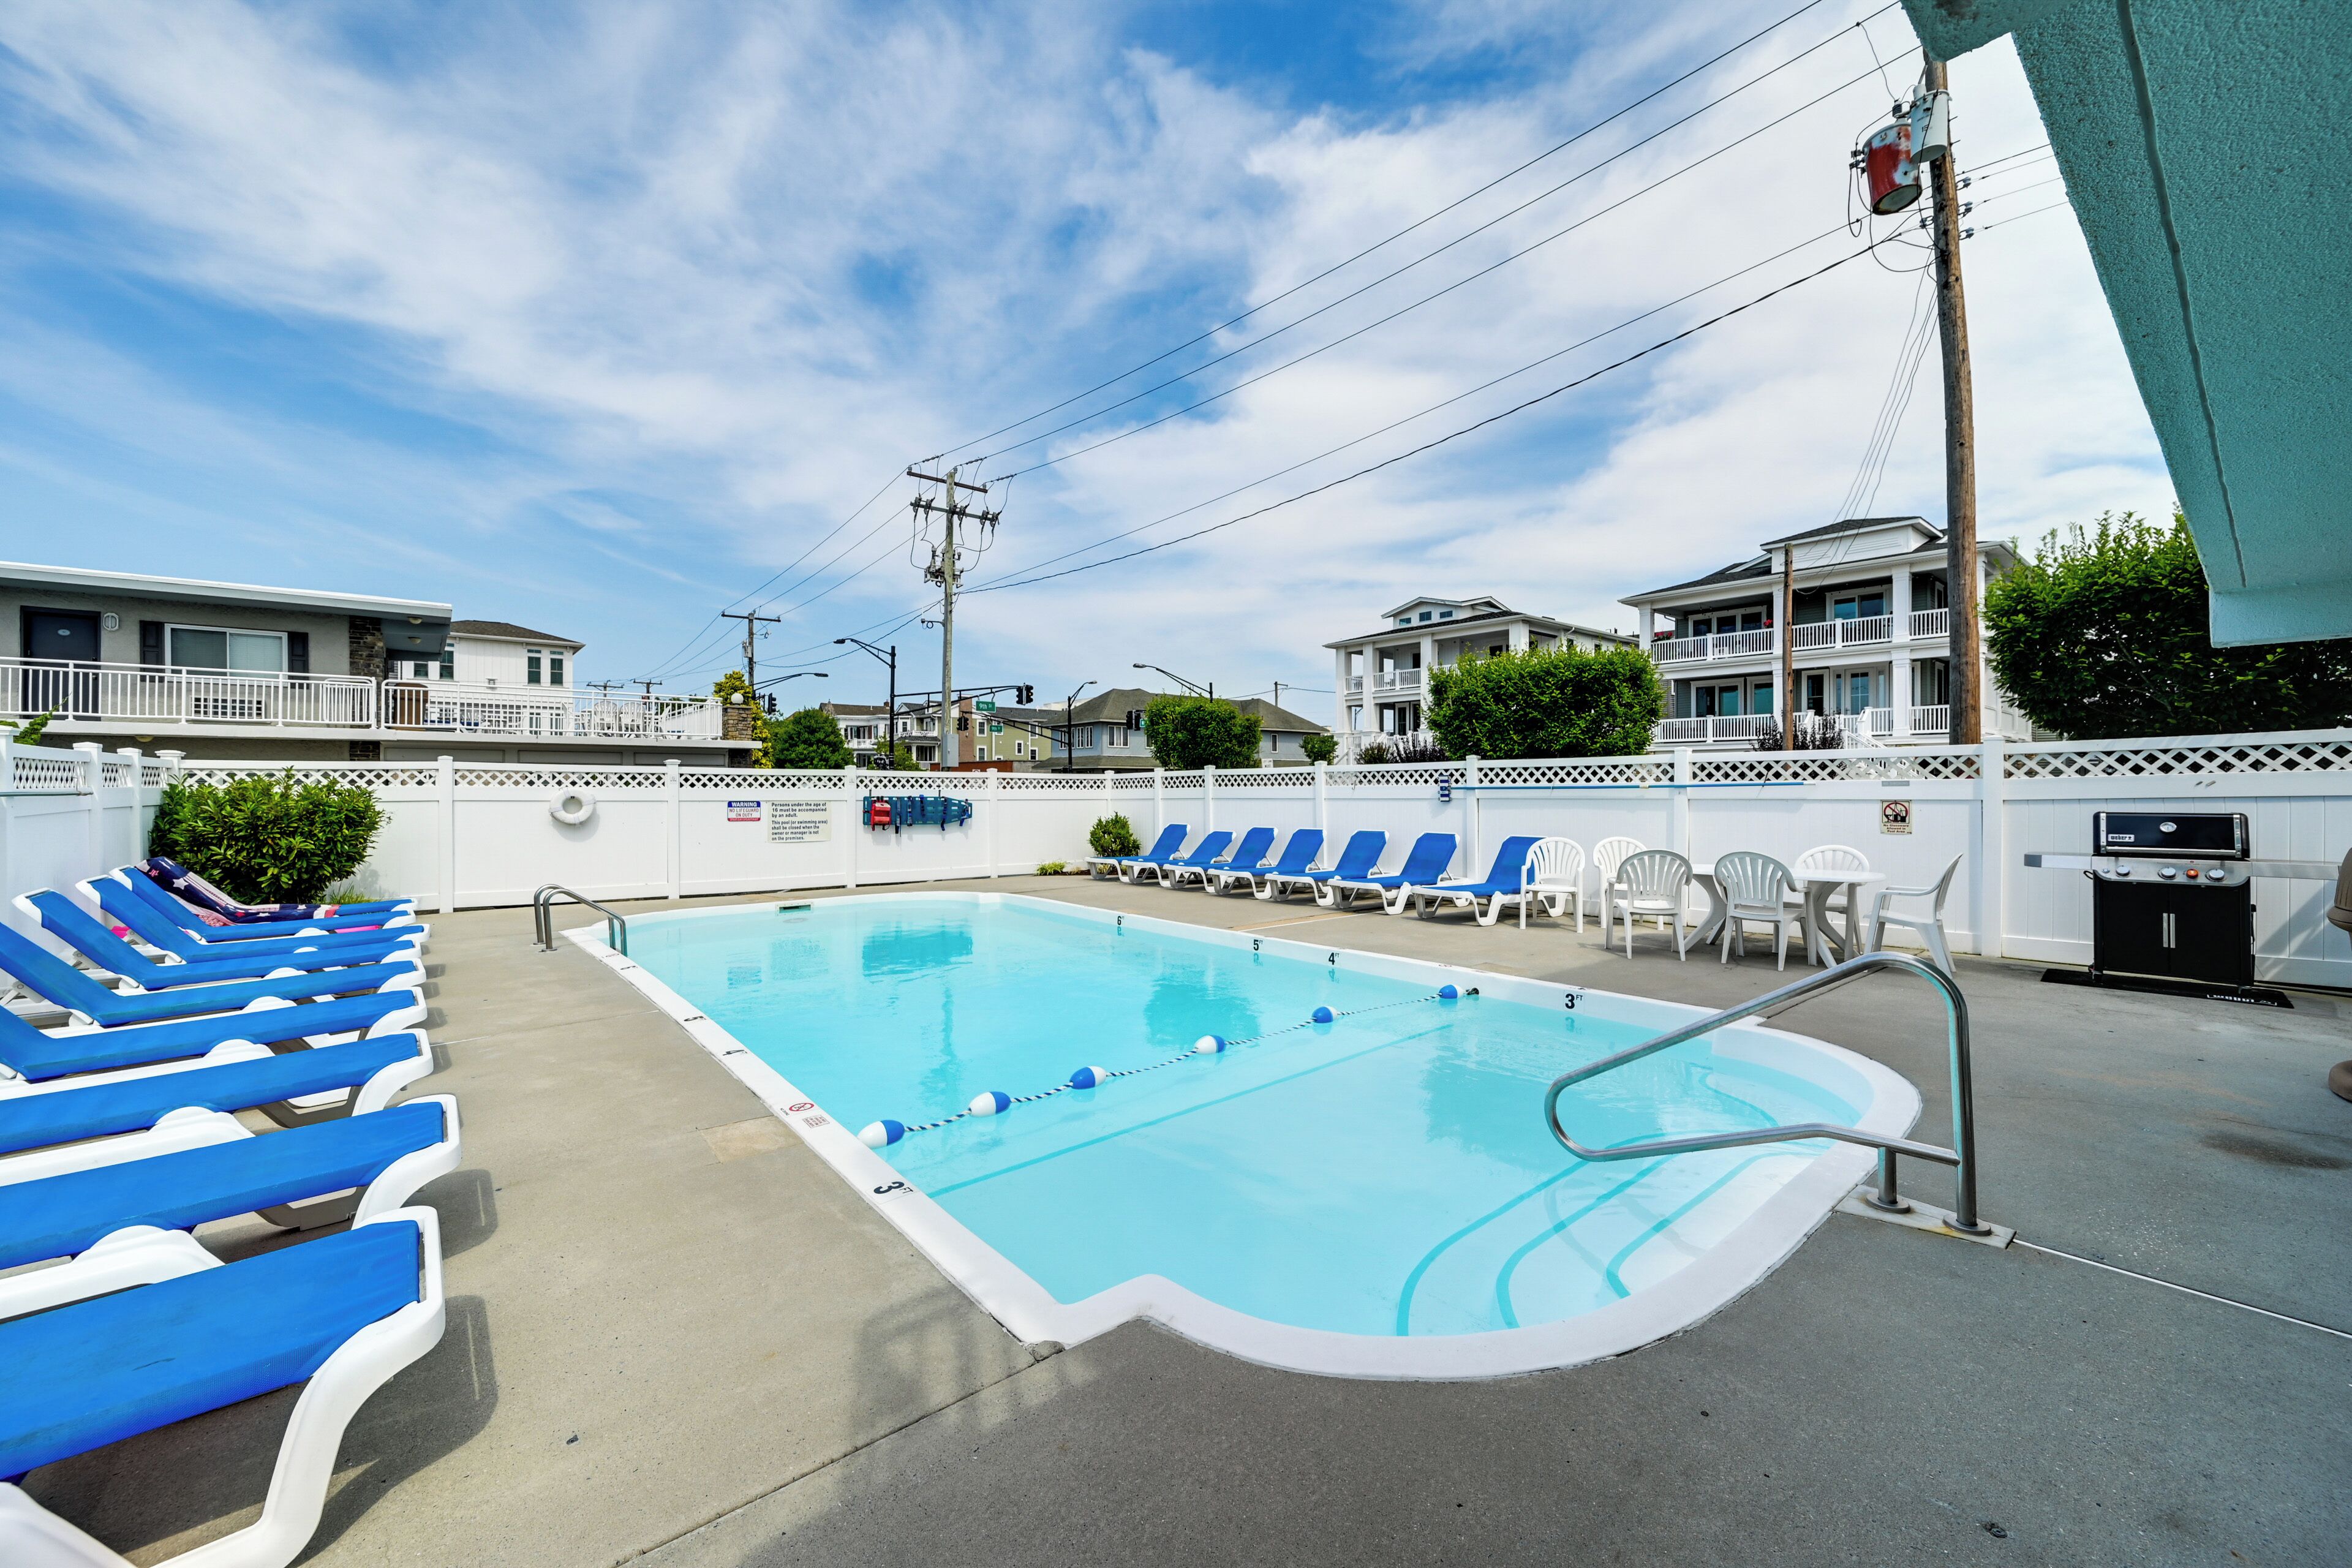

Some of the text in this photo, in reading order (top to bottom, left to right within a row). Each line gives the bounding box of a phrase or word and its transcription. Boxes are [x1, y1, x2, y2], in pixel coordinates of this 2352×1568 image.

[1118, 916, 1121, 925] 6
[1254, 939, 1259, 951] 5
[1329, 952, 1335, 965] 4
[1566, 993, 1575, 1009] 3
[874, 1182, 905, 1194] 3
